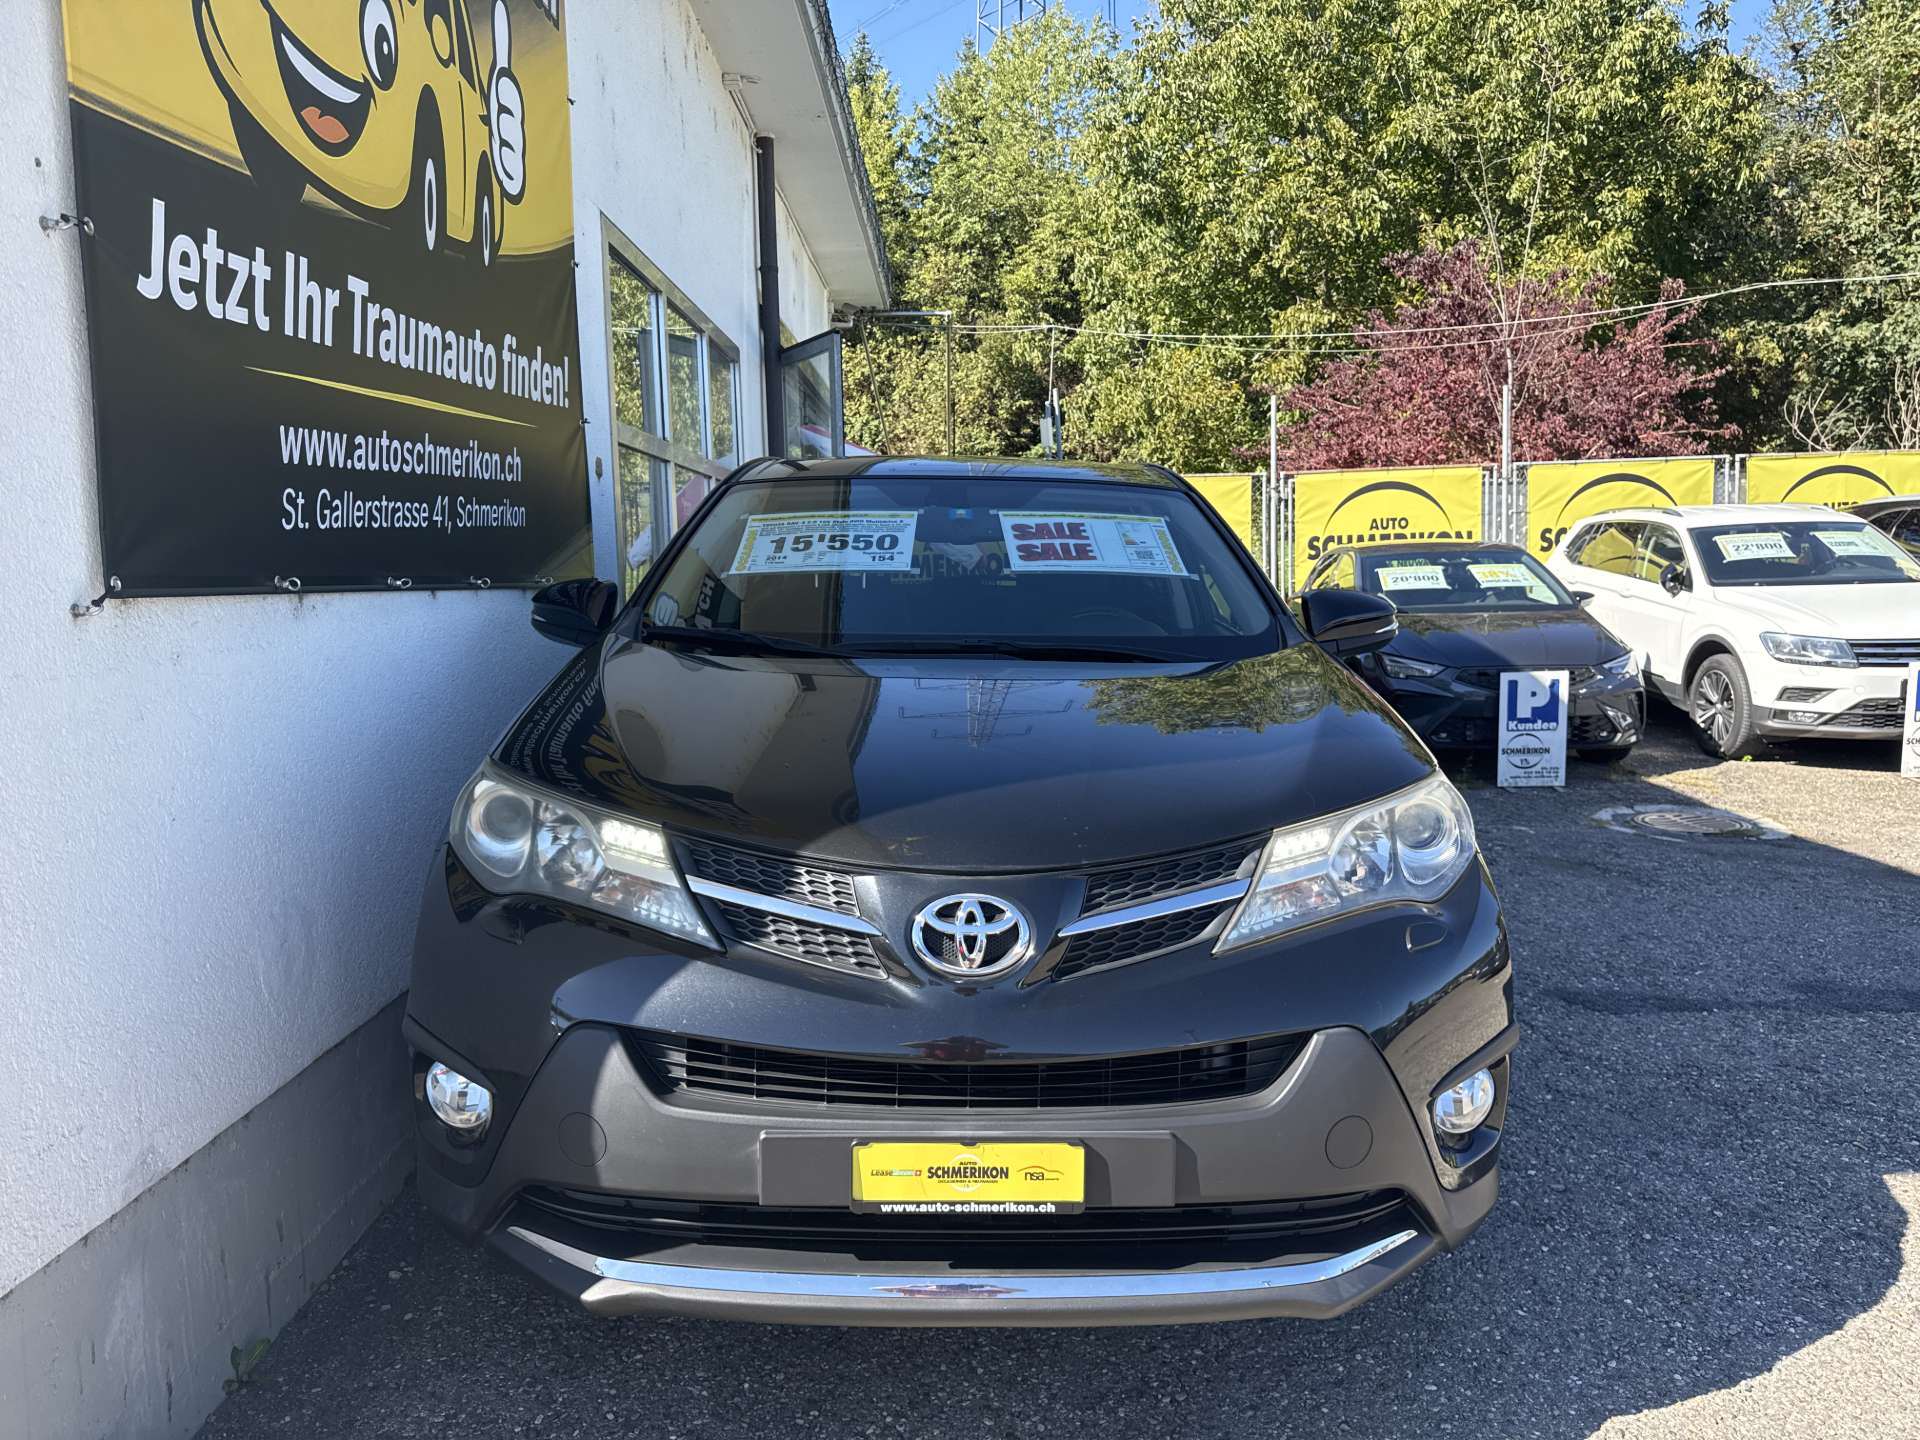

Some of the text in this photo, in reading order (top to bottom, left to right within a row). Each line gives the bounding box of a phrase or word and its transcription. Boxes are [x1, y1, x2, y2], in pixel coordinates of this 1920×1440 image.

[136, 198, 570, 408] Jetzt Ihr Traumauto finden!
[279, 425, 522, 482] www.autoschmerikon.ch
[282, 488, 526, 534] St. Gallerstrasse 41, Schmerikon
[1369, 517, 1409, 531] AUTO
[1010, 521, 1090, 542] SALE
[769, 533, 900, 555] 15'550
[1015, 542, 1098, 562] SALE
[1391, 575, 1440, 584] 20'800
[1508, 720, 1557, 731] Kunden
[1501, 747, 1550, 756] SCHMERIKON
[927, 1166, 1009, 1179] SCHMERIKON
[1024, 1171, 1045, 1181] nsa
[880, 1202, 1056, 1213] www.auto-schmerikon.ch
